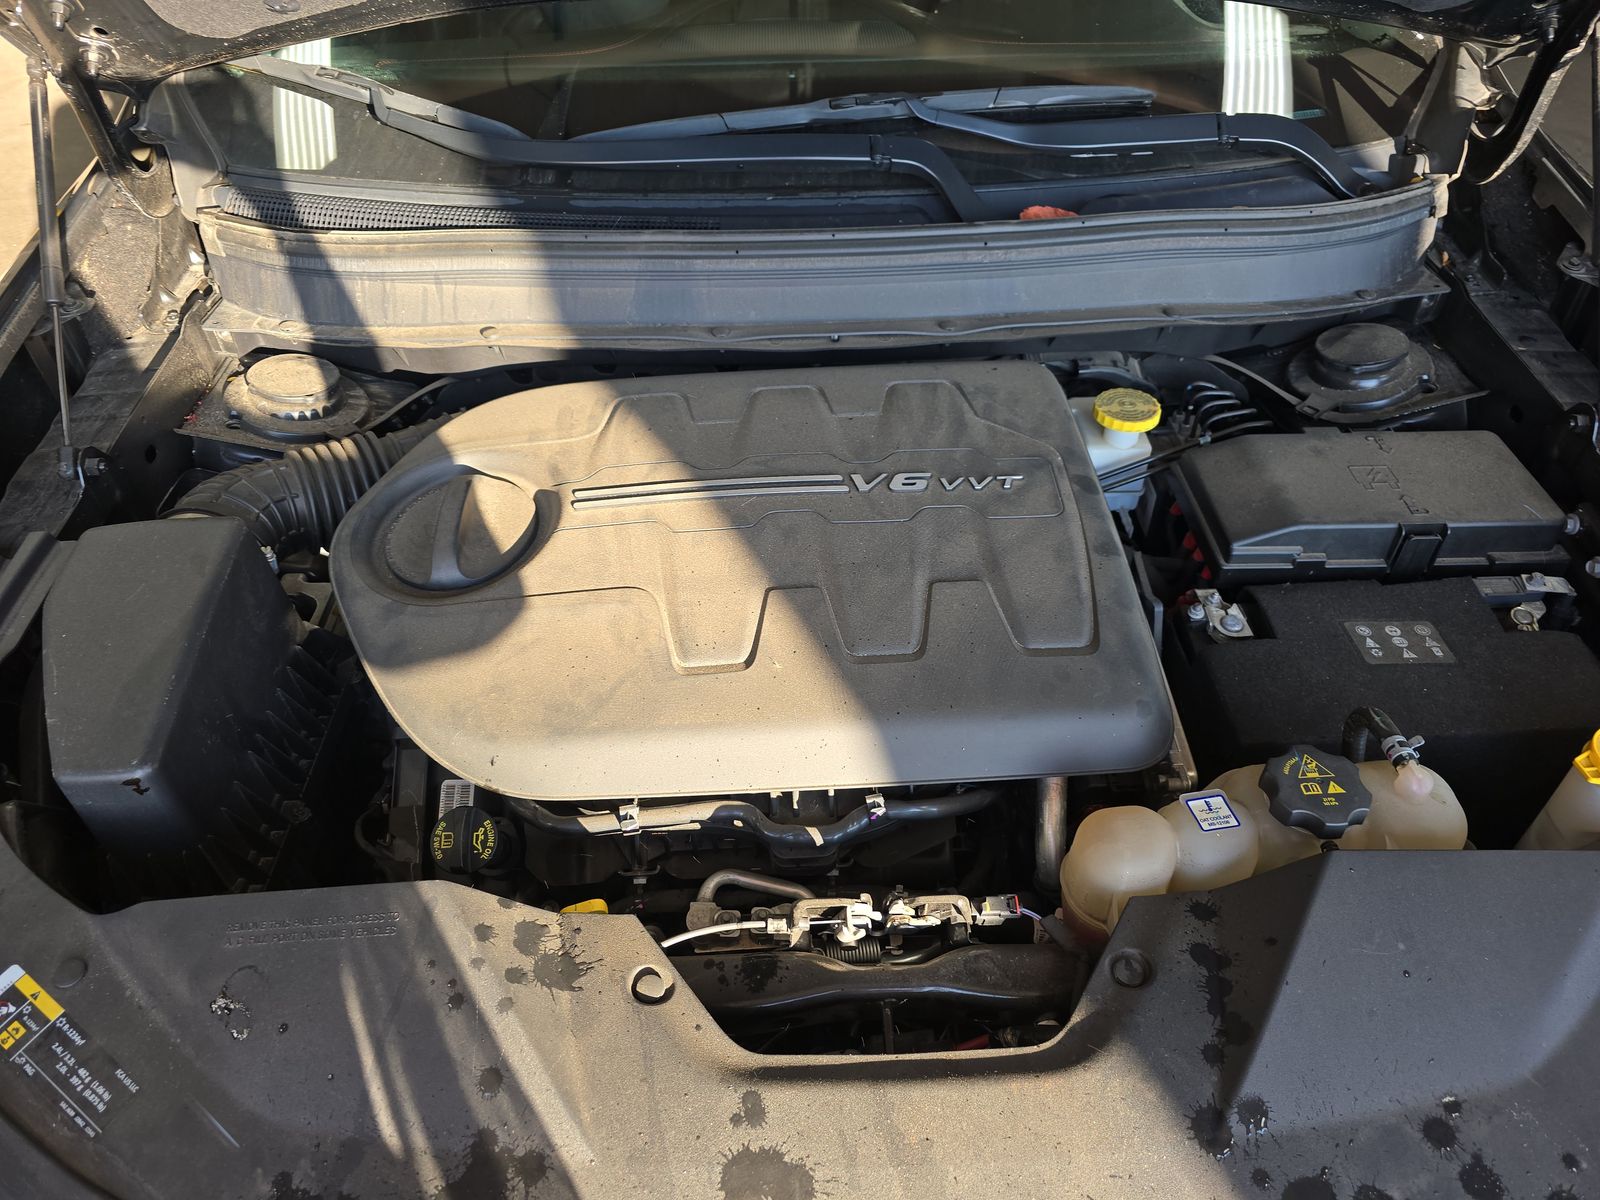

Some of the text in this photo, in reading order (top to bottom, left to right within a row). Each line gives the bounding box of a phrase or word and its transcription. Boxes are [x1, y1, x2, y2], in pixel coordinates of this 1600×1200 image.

[850, 473, 1023, 492] V6 VVT
[1210, 814, 1232, 822] COOLANT
[435, 821, 446, 835] SAE
[480, 820, 495, 860] ENGINE OIL
[23, 1063, 36, 1076] PAG
[114, 1068, 126, 1080] FCA
[122, 1076, 132, 1086] US
